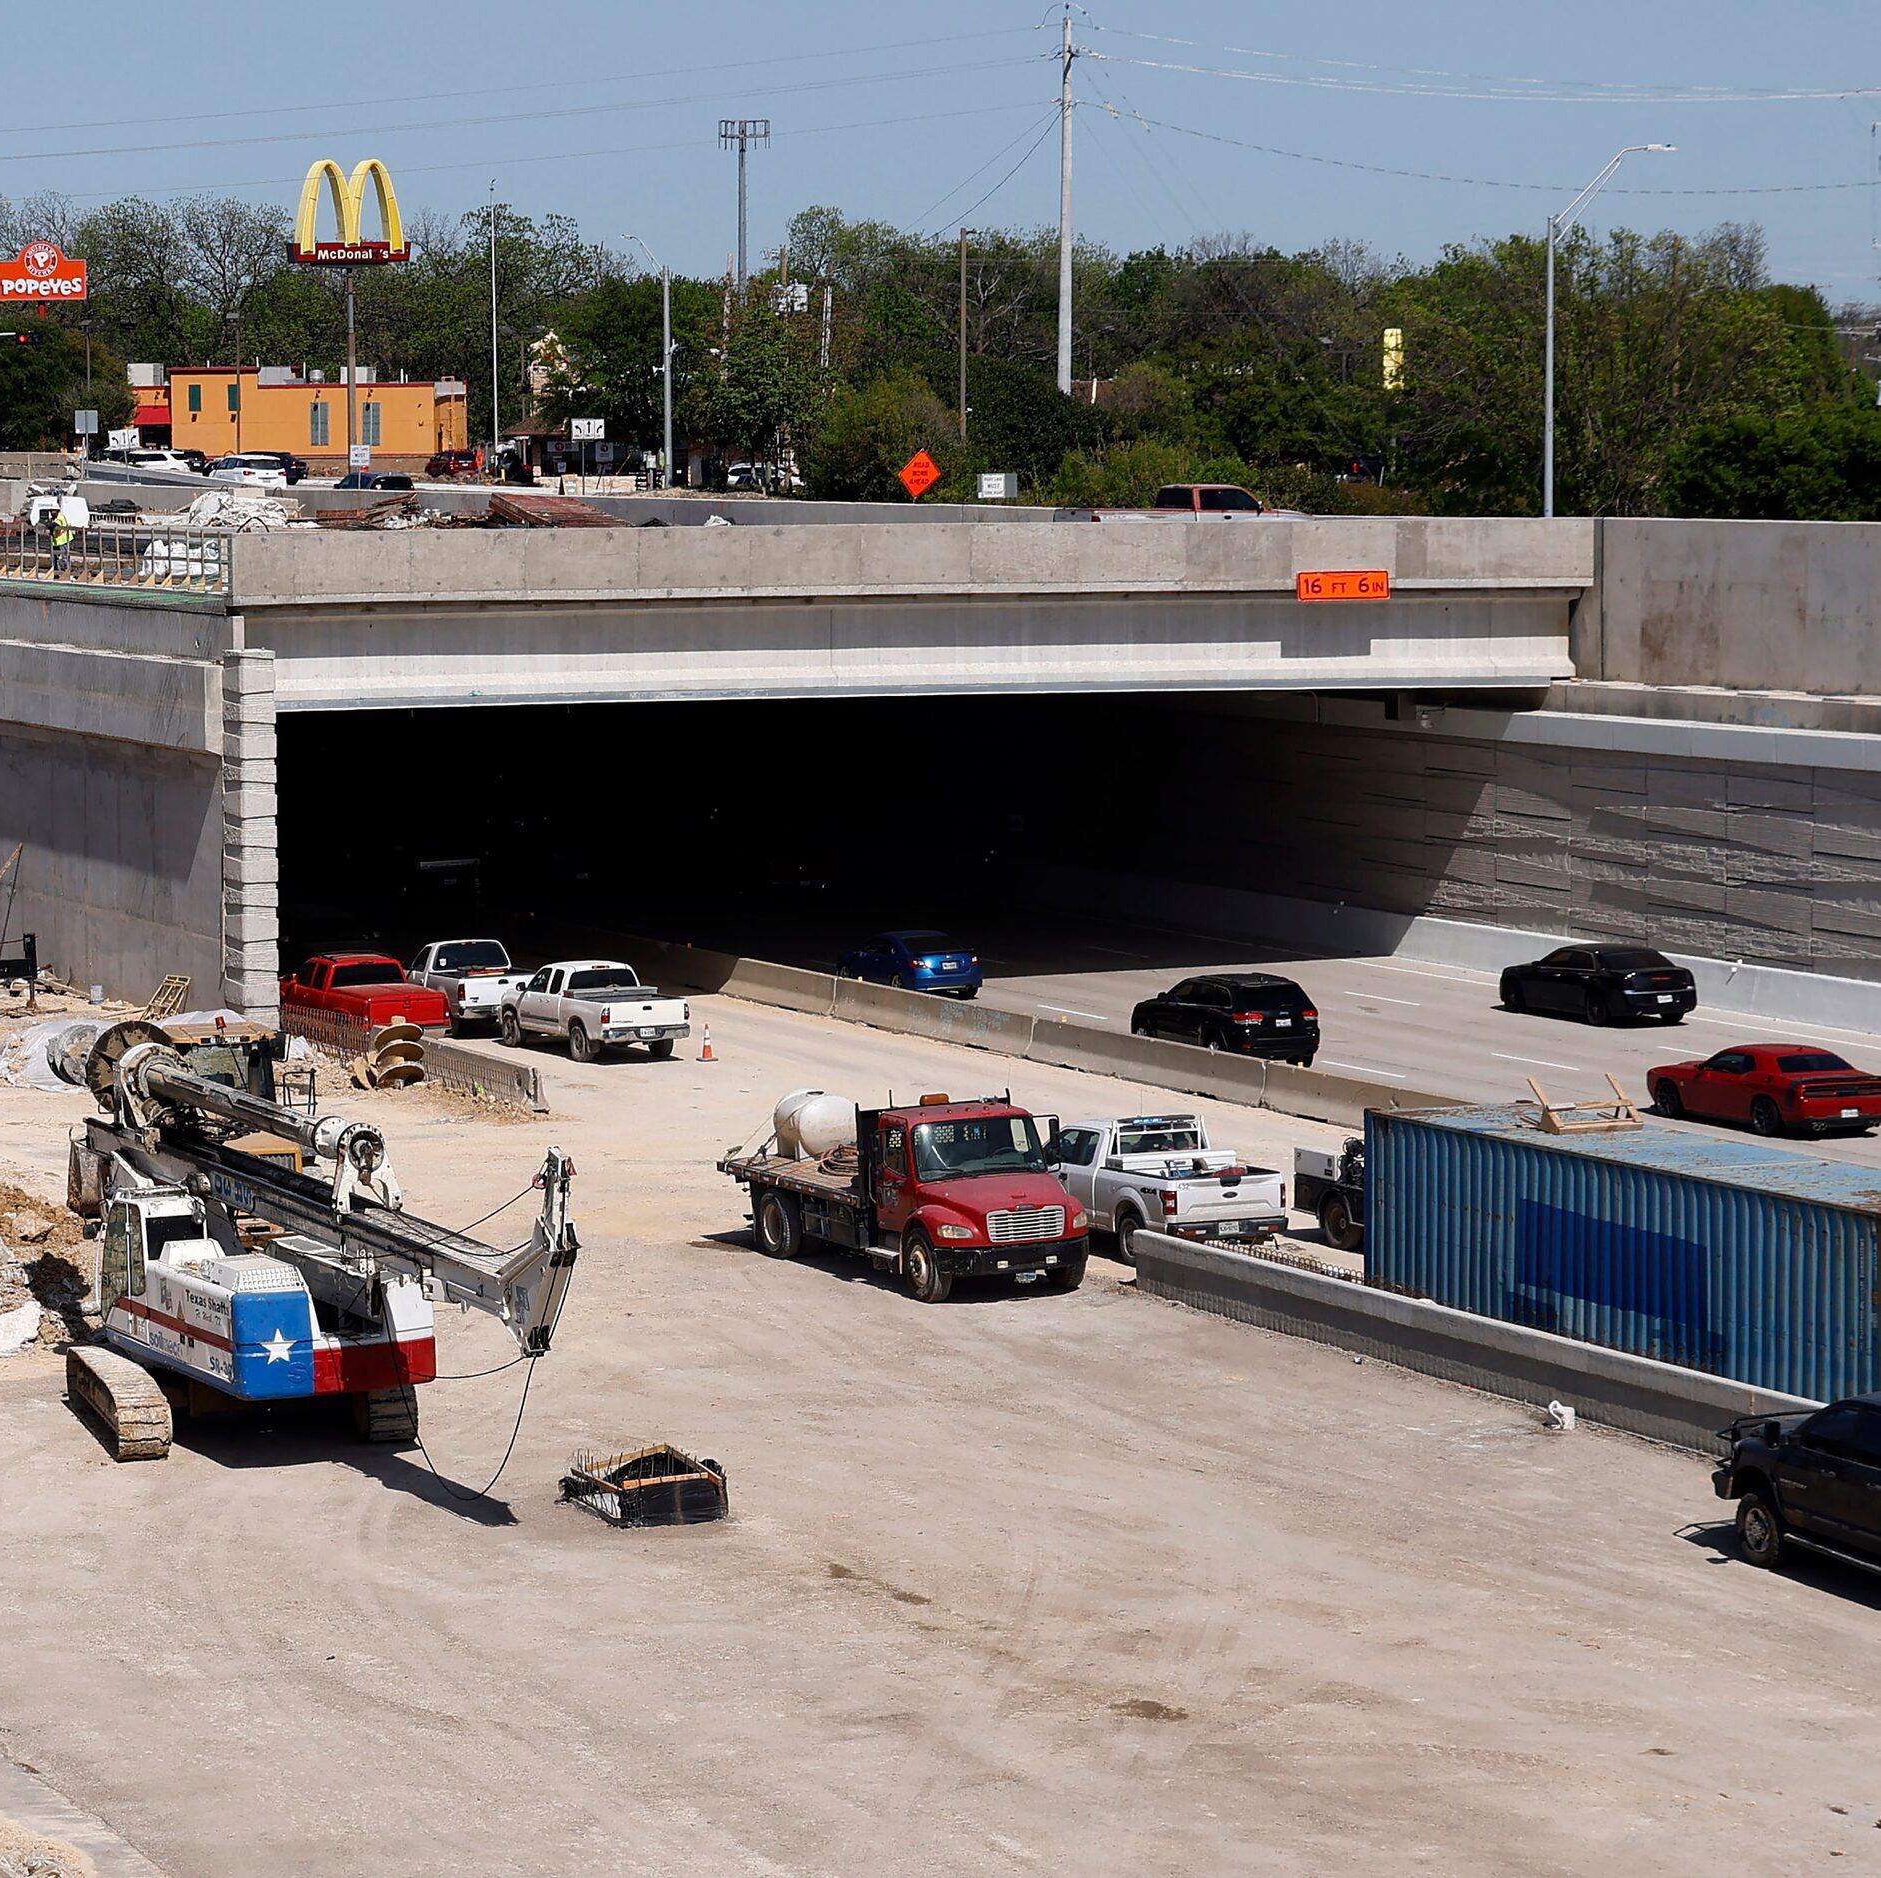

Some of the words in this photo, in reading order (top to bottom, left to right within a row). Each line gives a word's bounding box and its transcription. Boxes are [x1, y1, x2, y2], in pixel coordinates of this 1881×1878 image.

[1303, 578, 1322, 595] 16
[1331, 582, 1347, 593] FT
[1358, 577, 1370, 593] 6
[1372, 581, 1384, 593] IN
[185, 1289, 207, 1308] Texas
[207, 1296, 230, 1316] Shafts
